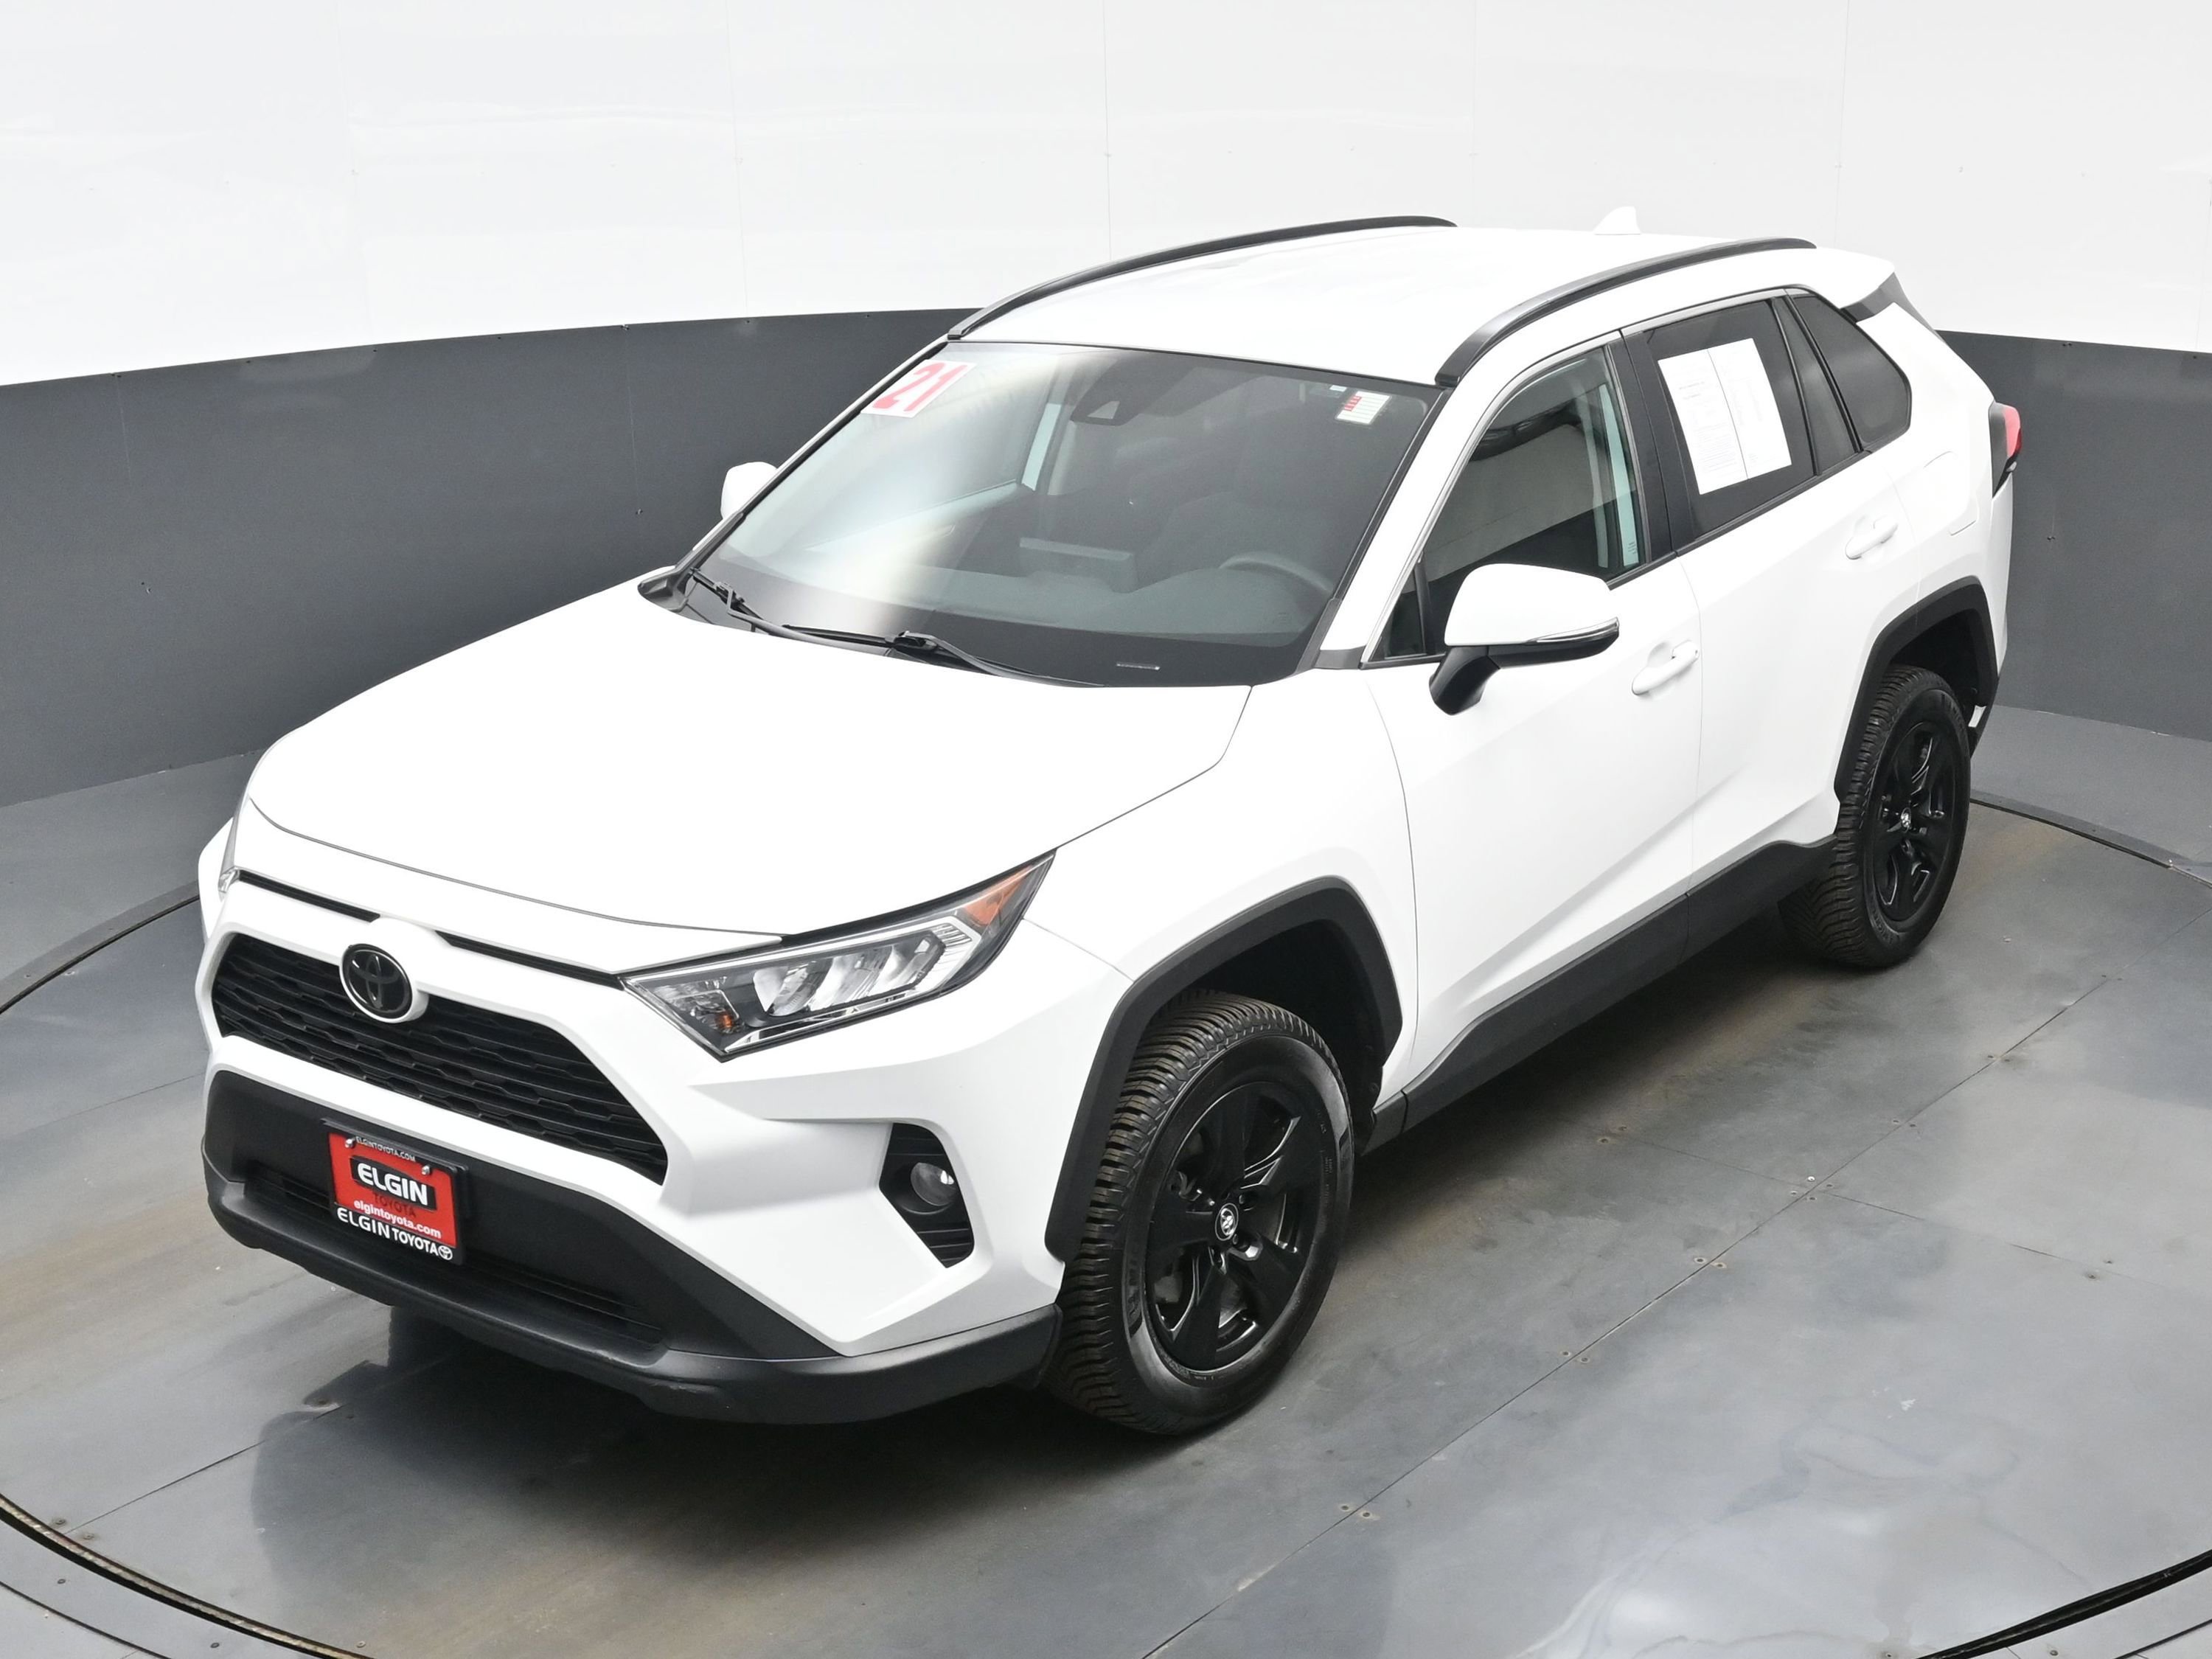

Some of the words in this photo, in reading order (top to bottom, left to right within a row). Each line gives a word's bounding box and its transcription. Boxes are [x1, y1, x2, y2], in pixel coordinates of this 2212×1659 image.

[873, 363, 967, 411] 21
[356, 1136, 416, 1162] ELGINTOYOTA.COM
[358, 1163, 428, 1206] ELGIN
[373, 1192, 417, 1217] TOYOTA
[337, 1207, 390, 1239] ELGIN
[392, 1228, 439, 1256] TOYOTA
[354, 1200, 442, 1239] elgintoyota.com
